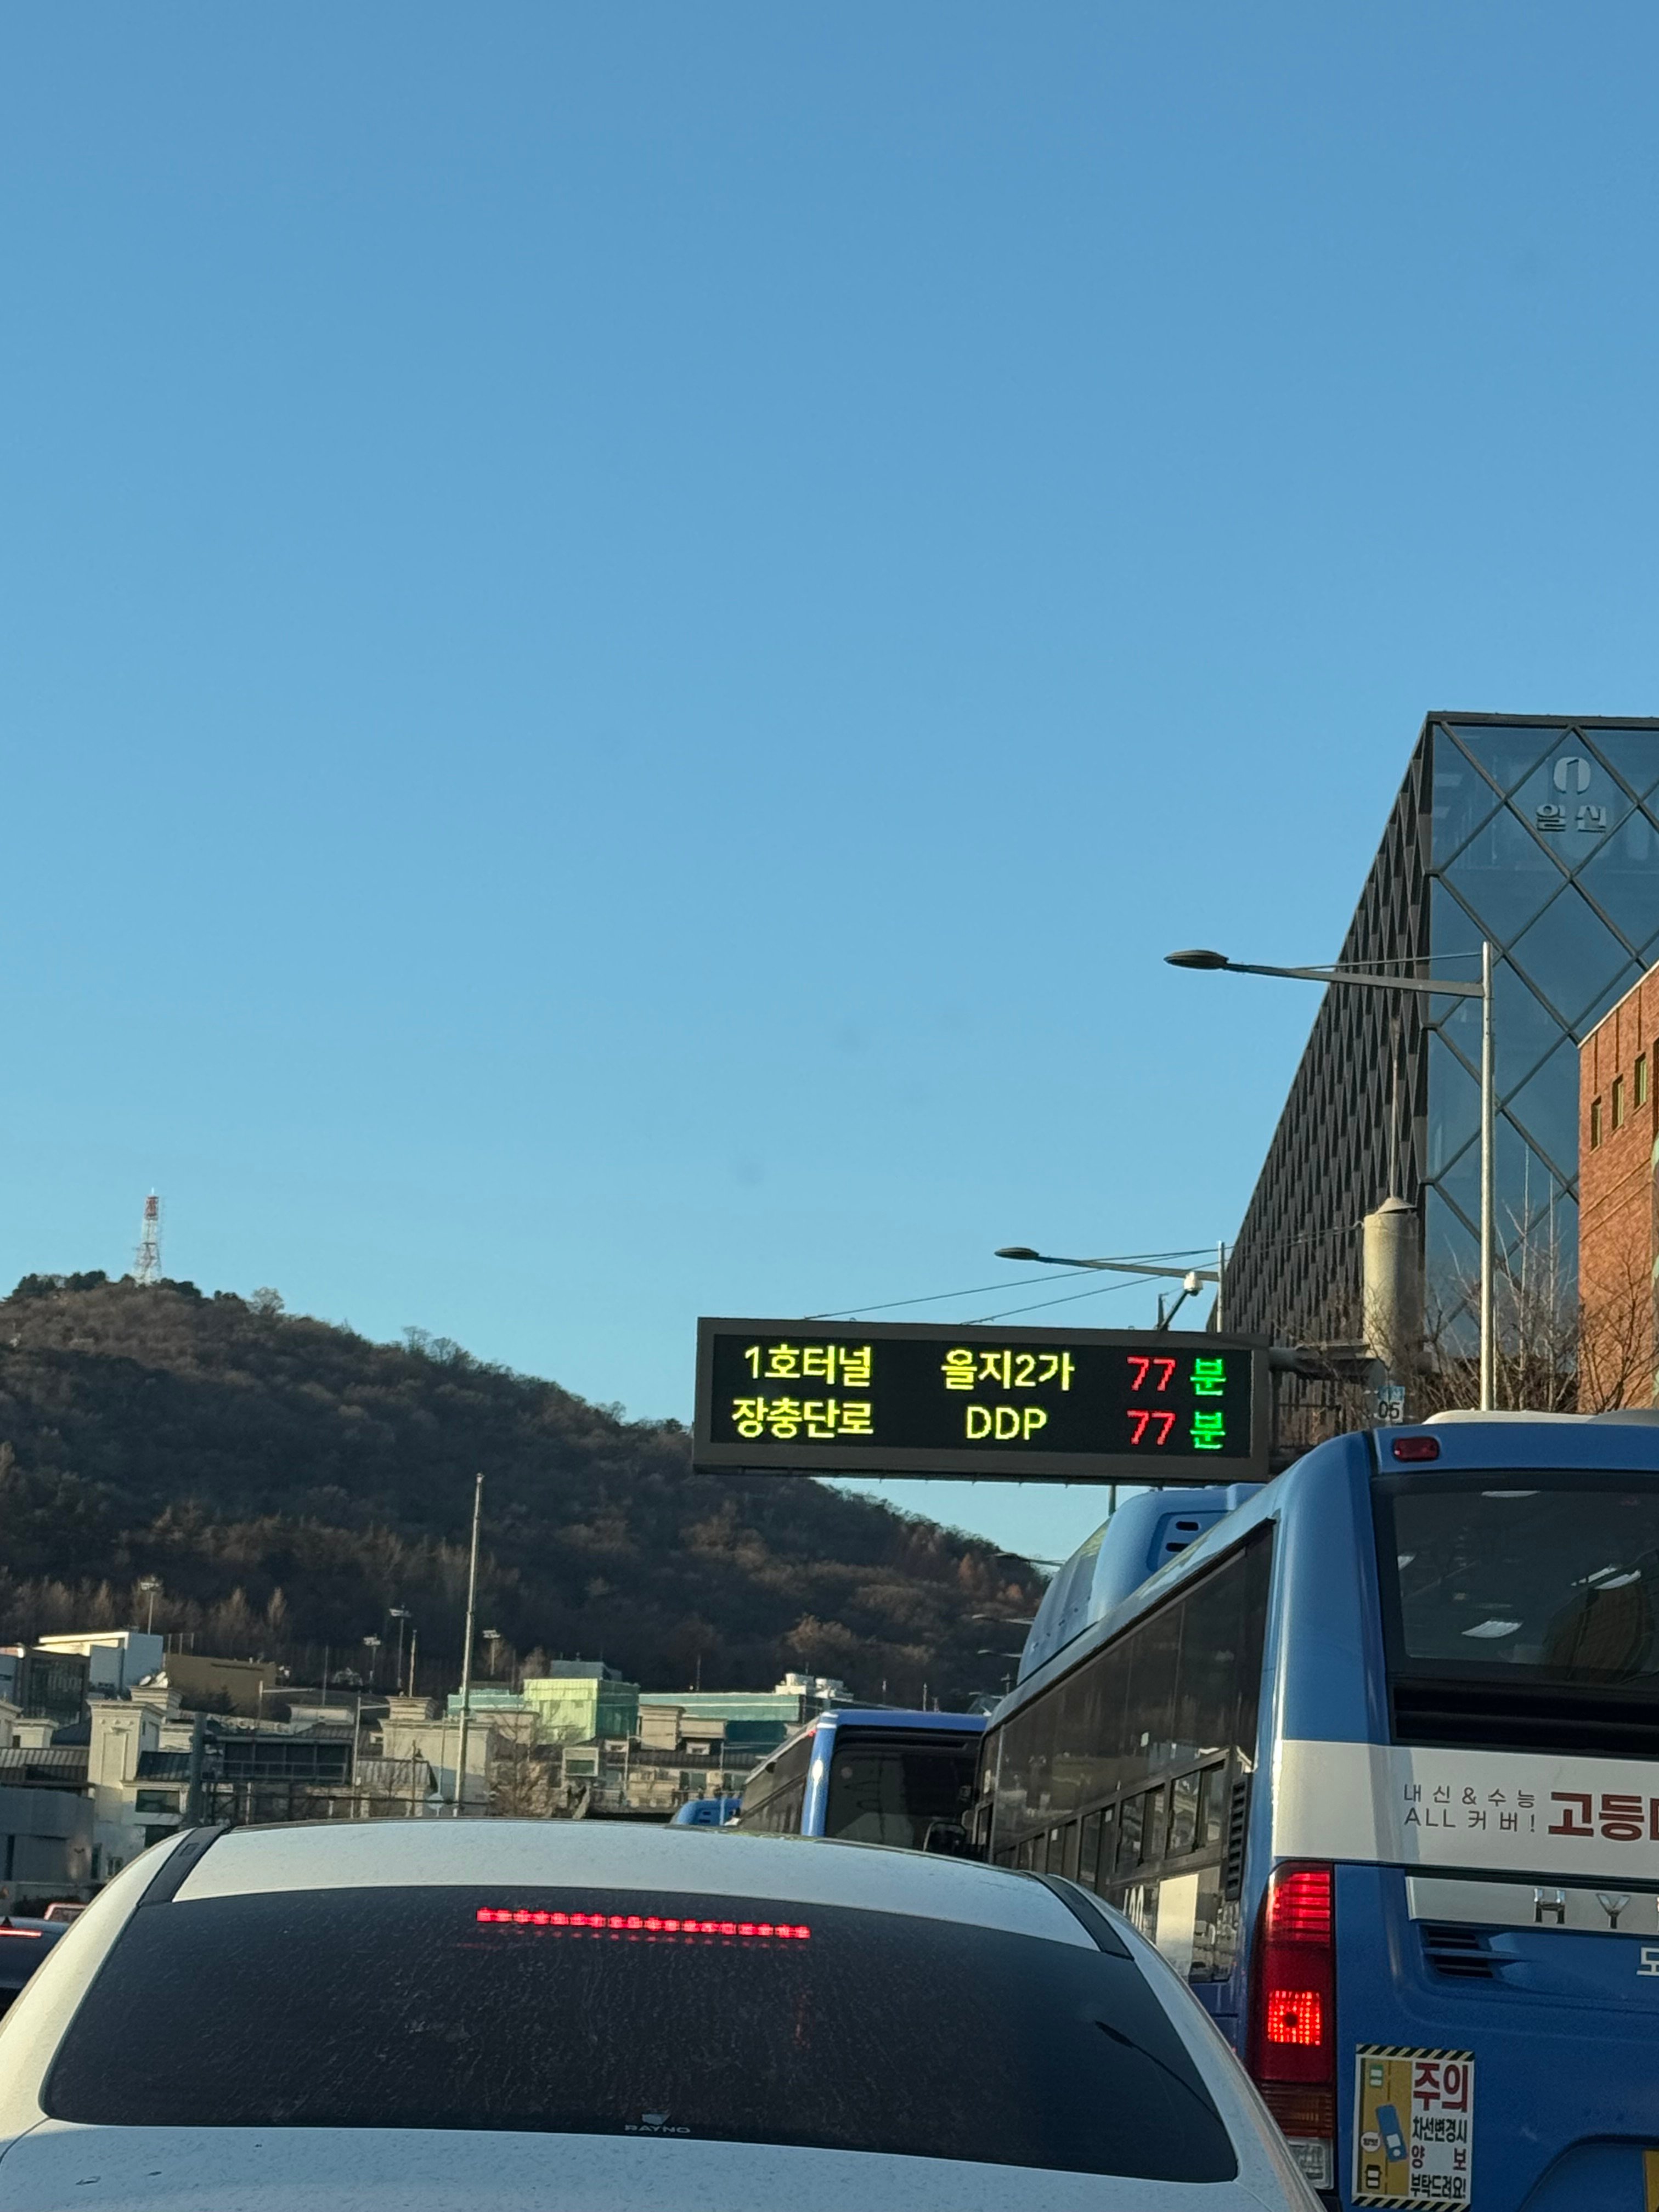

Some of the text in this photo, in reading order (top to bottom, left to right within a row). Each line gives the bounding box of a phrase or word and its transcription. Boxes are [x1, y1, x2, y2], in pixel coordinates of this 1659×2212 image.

[1537, 804, 1607, 833] 일신
[744, 1344, 1227, 1396] 1호터널 을지2가 77 분
[731, 1397, 1227, 1449] 장충단로 DDP 77 분
[1379, 1400, 1400, 1419] 05
[1403, 1807, 1456, 1828] ALL
[1548, 1792, 1659, 1841] 고등
[1534, 1887, 1659, 1932] HY
[1413, 2062, 1469, 2113] 주의
[624, 2124, 691, 2133] RAYNO
